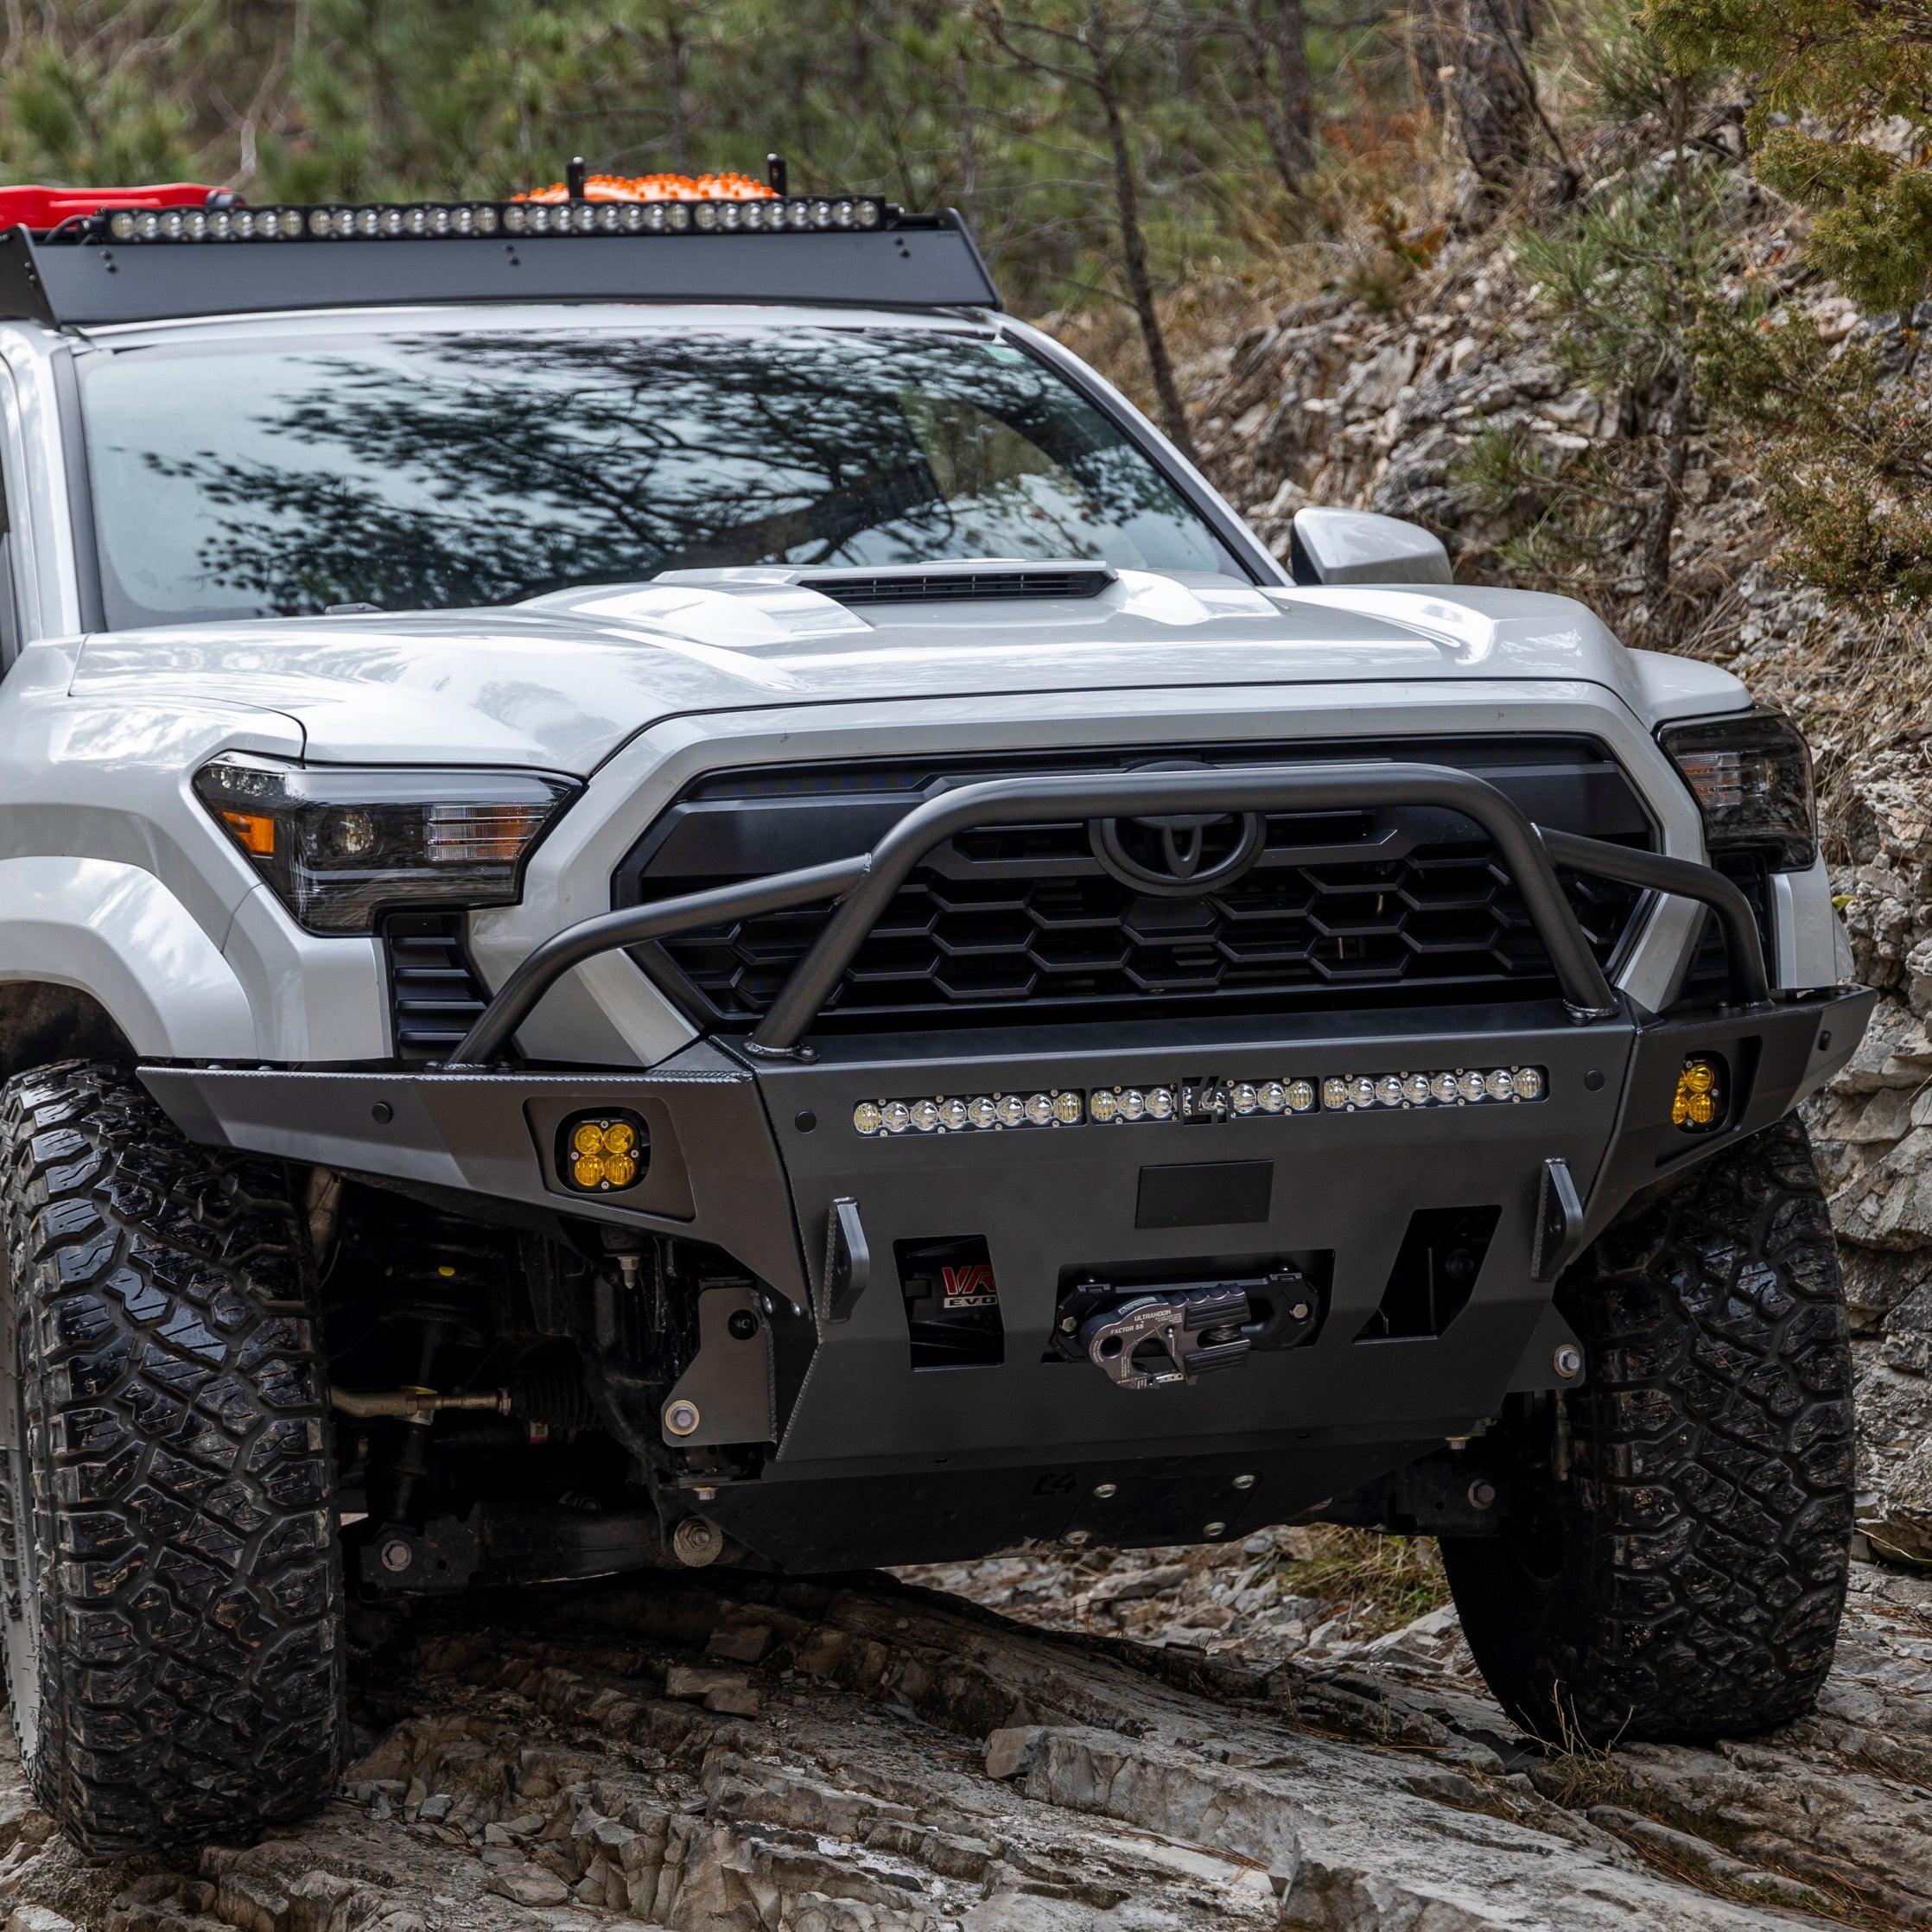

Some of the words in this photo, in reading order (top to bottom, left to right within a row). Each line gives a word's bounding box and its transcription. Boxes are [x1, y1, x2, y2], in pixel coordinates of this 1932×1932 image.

[950, 1297, 995, 1306] EVO
[1134, 1309, 1172, 1321] ULTRAHOOK
[1110, 1326, 1134, 1335] FACTOR
